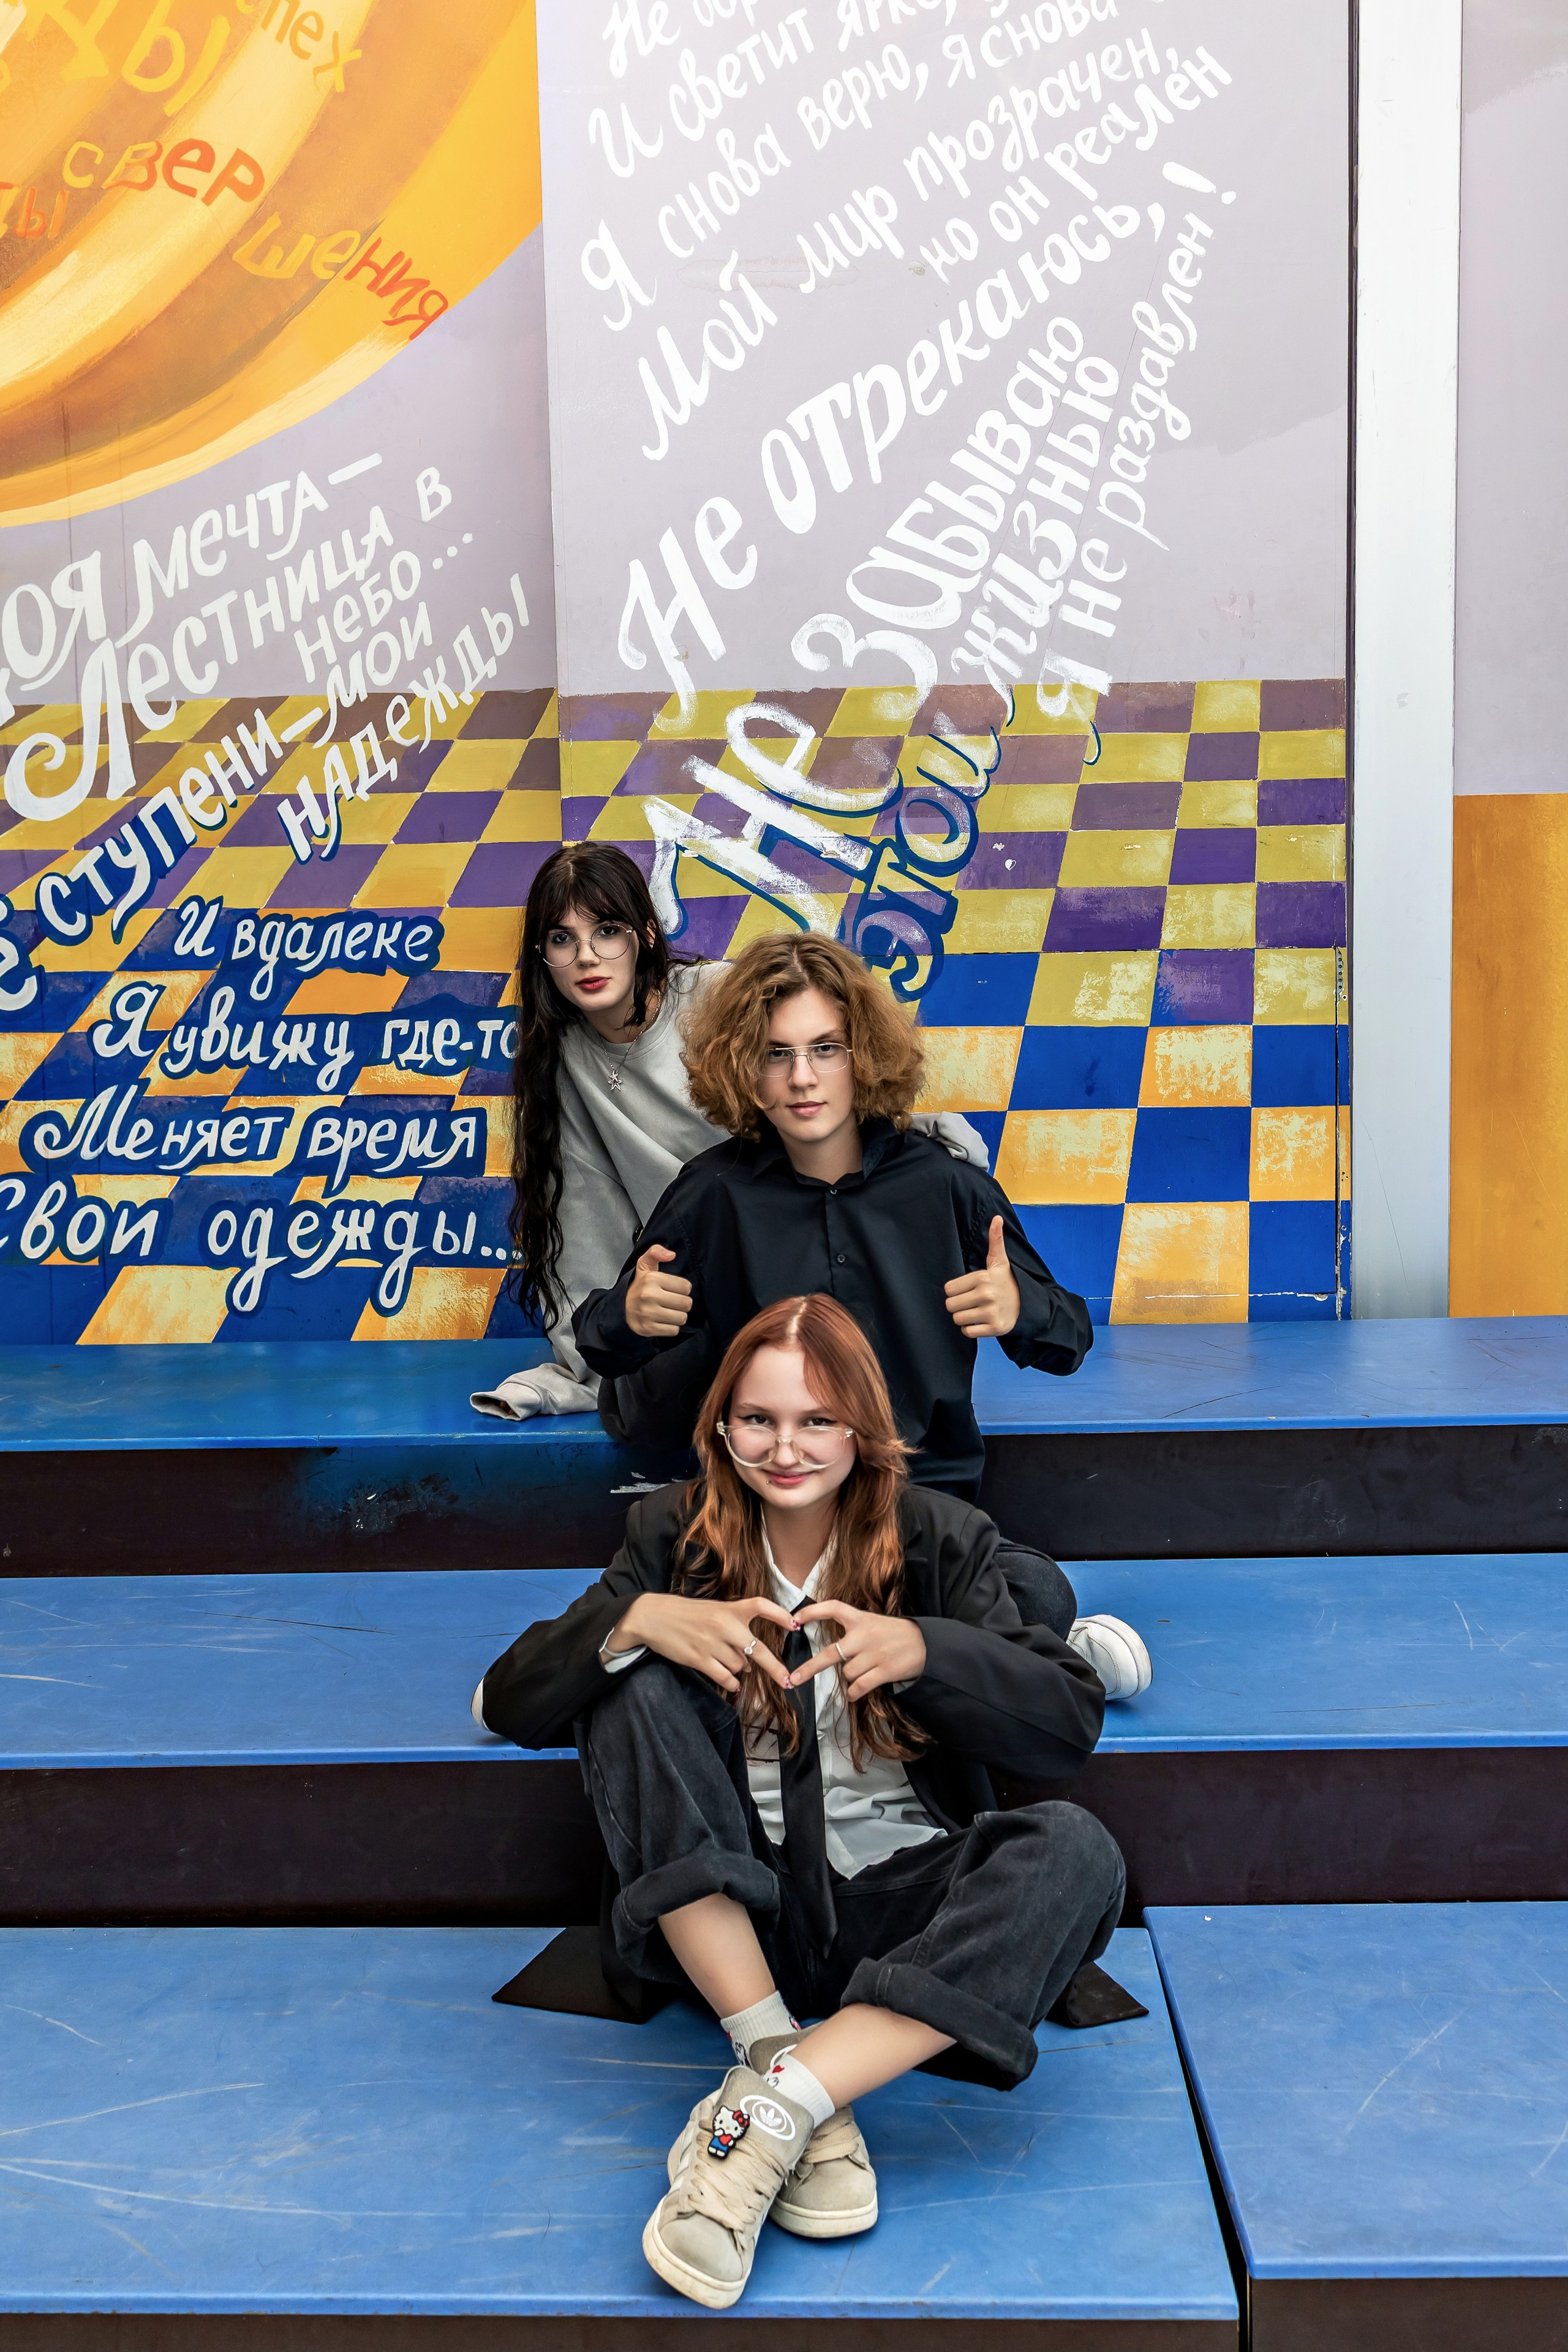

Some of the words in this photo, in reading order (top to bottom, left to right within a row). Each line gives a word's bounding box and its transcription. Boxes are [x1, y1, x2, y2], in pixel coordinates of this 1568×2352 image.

[588, 102, 663, 178] И
[669, 6, 817, 142] светит
[580, 219, 657, 331] Я
[658, 127, 792, 259] снова
[799, 181, 905, 294] мир
[919, 217, 979, 285] но
[989, 176, 1050, 243] он
[617, 496, 758, 731] Не
[1059, 538, 1128, 637] не
[173, 900, 221, 958] И
[232, 916, 434, 1001] вдалеке
[93, 984, 159, 1058] Я
[165, 985, 355, 1093] увижу
[34, 1084, 285, 1170] Меняет
[306, 1115, 477, 1191] время
